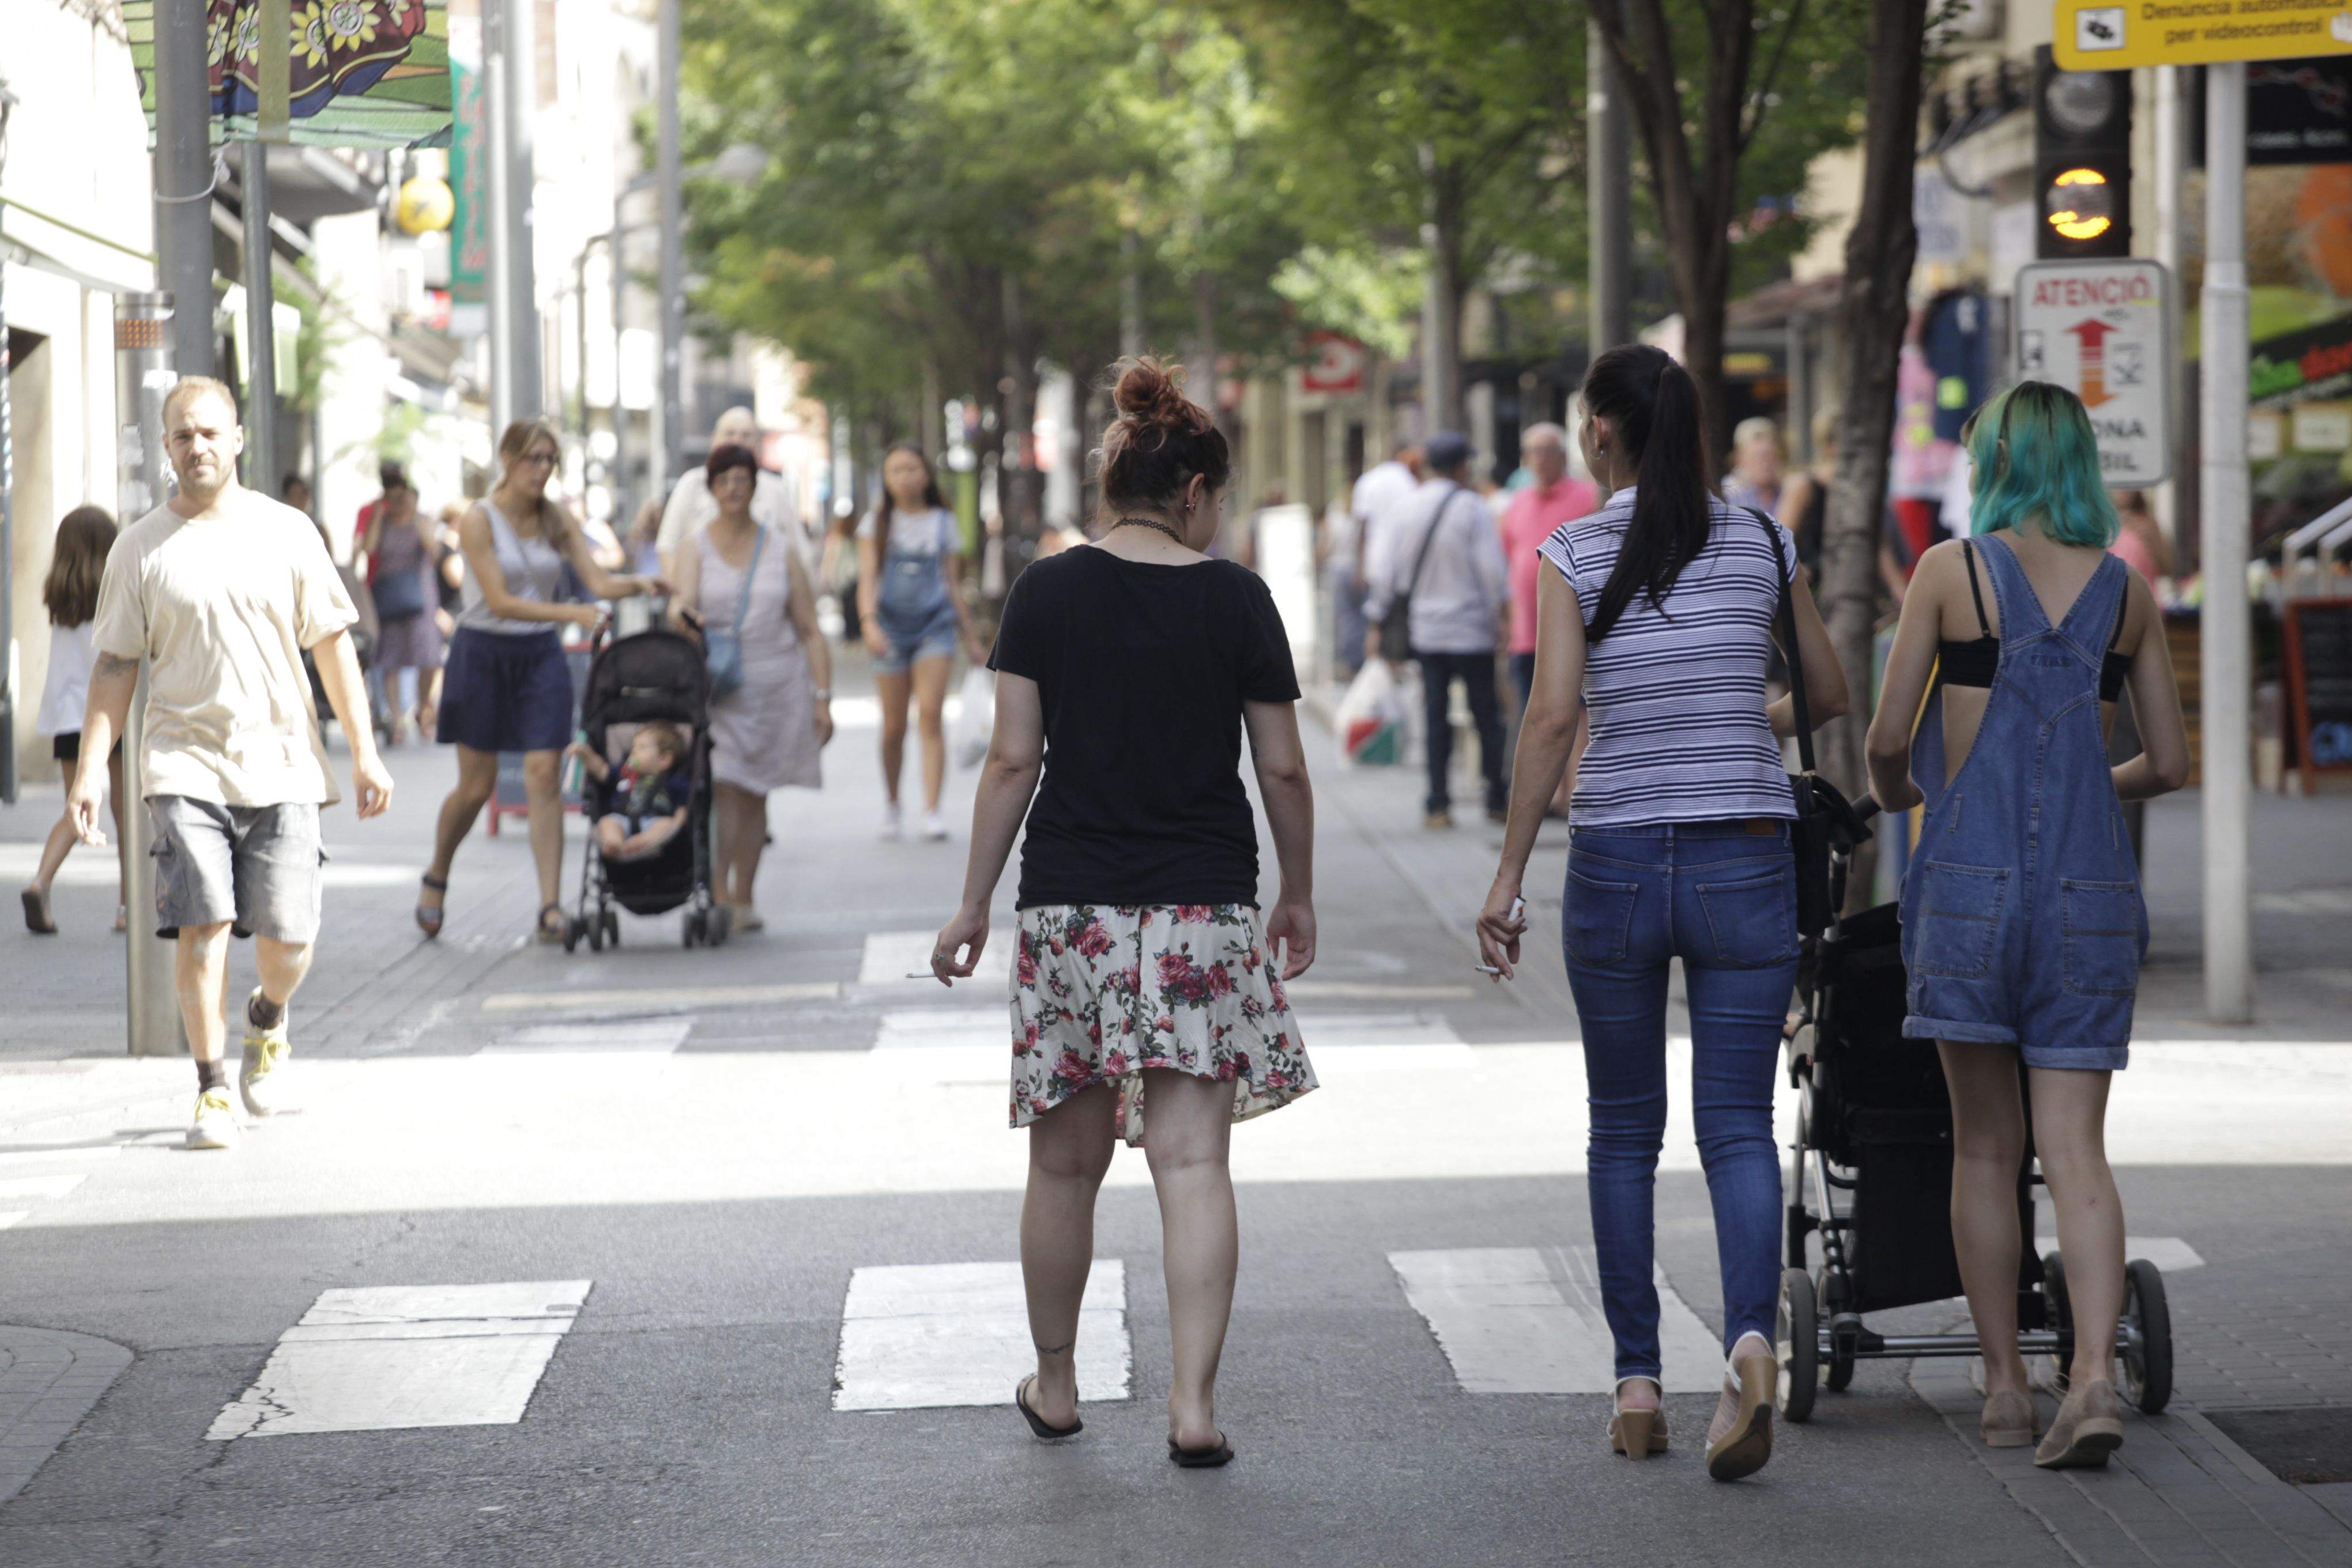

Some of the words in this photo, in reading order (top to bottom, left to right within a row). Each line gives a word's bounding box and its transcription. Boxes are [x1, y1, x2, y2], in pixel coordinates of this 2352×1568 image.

[2142, 1, 2232, 20] Denúncia
[2165, 30, 2195, 45] per
[2204, 18, 2322, 39] videocontrol
[2033, 273, 2152, 307] ATENCIÓ
